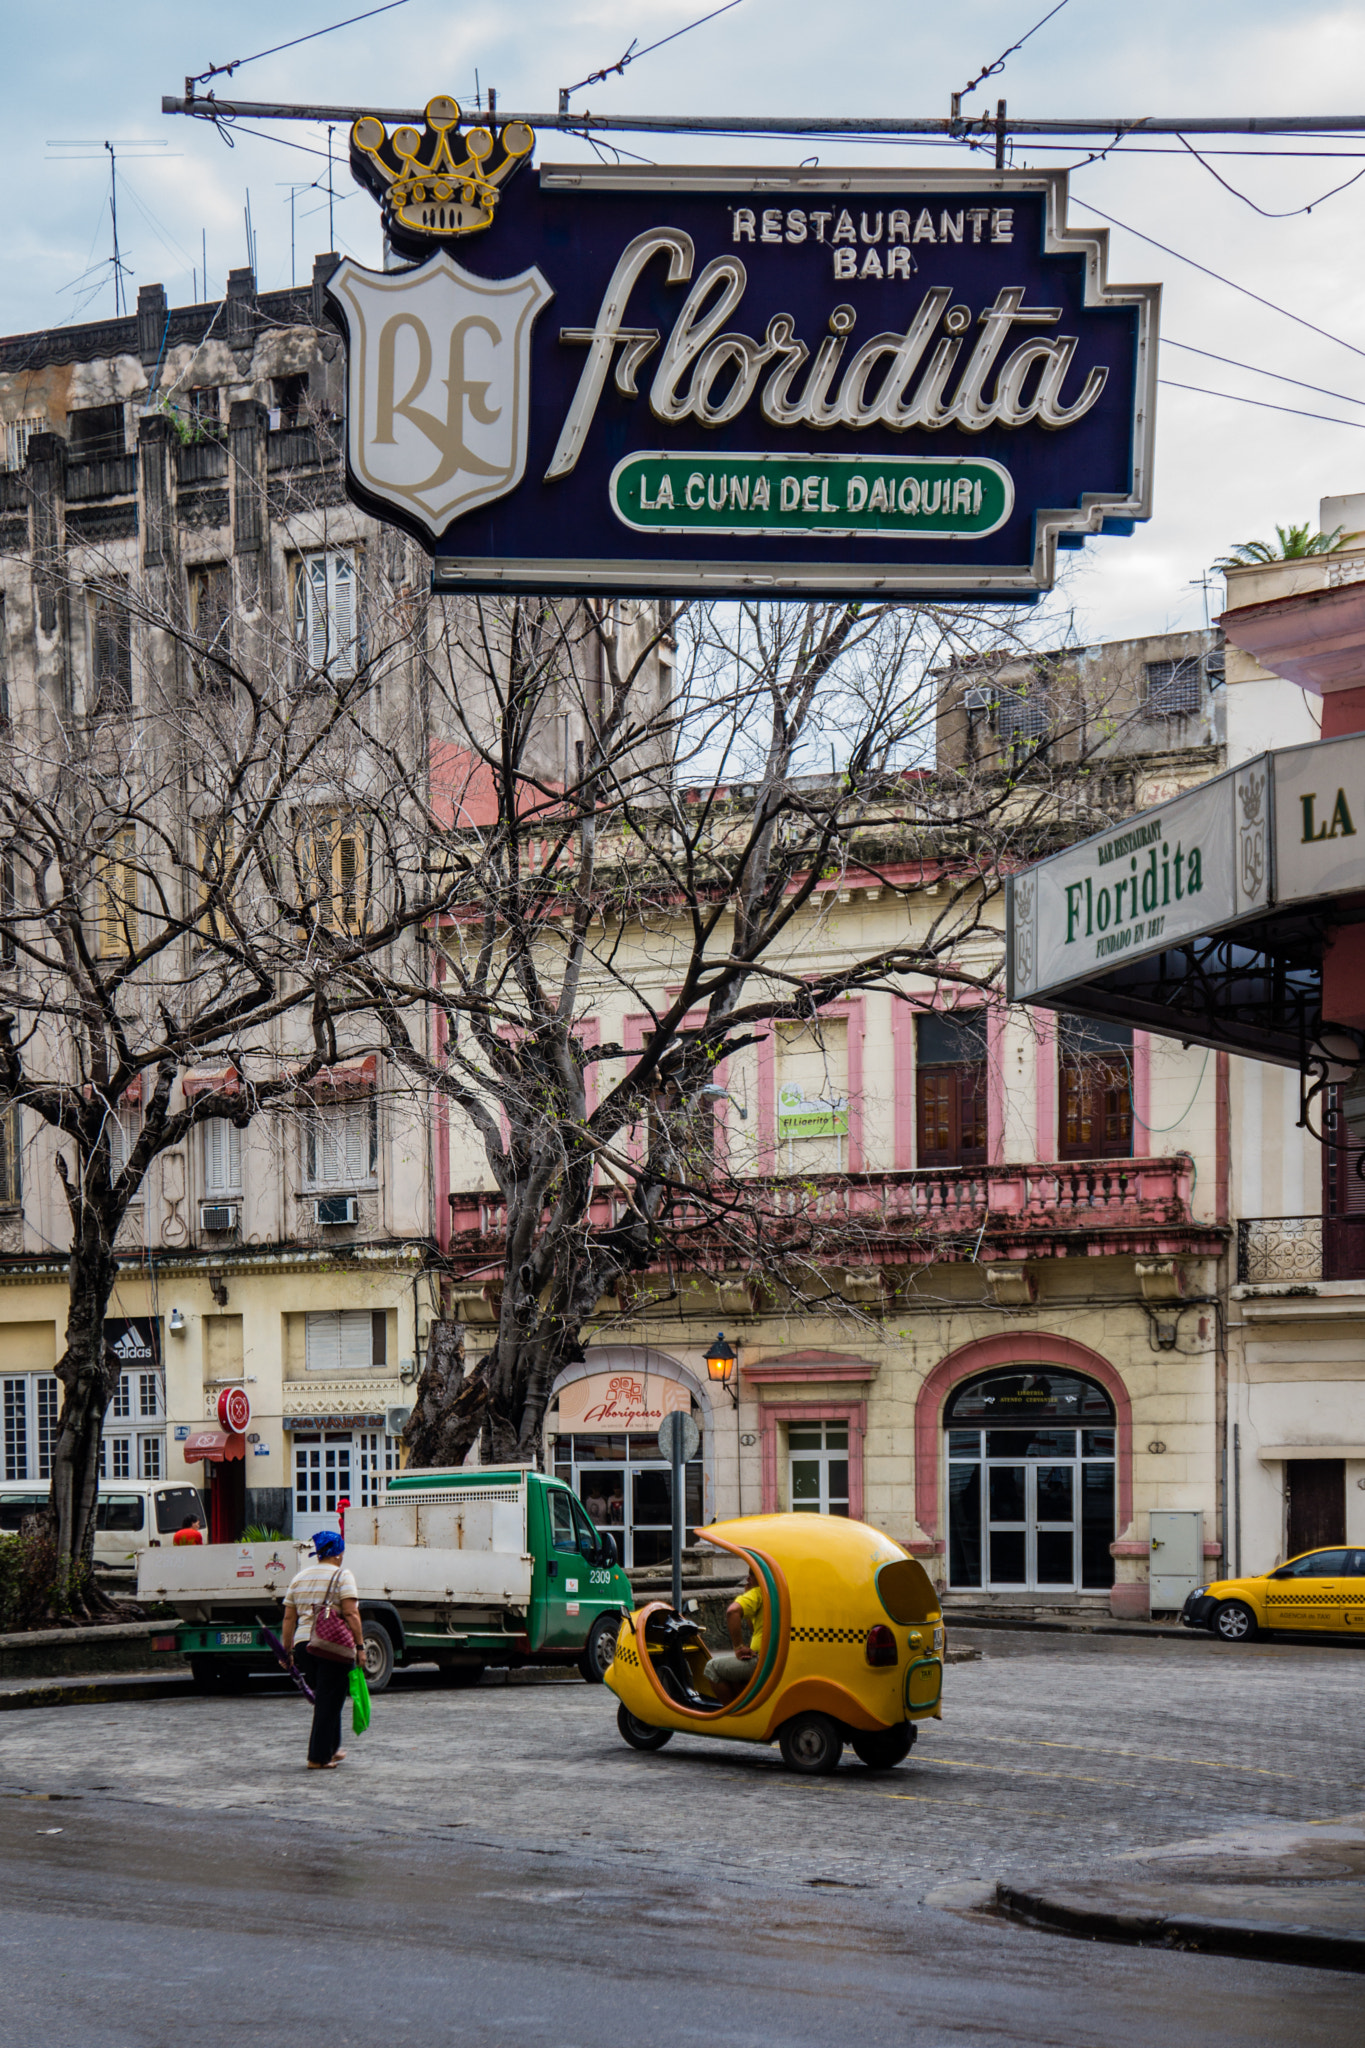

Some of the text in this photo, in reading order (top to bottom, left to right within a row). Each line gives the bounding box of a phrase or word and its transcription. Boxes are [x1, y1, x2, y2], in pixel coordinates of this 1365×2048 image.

[732, 208, 1015, 243] RESTAURANTE
[834, 246, 912, 279] BAR
[640, 472, 983, 516] LA CUNA DEL DAIQUIRI
[1300, 787, 1357, 844] LA
[1098, 819, 1162, 866] BAR RESTAURANT
[1065, 840, 1204, 945] Floridita
[1096, 915, 1166, 959] FUNDADO EN 1817
[783, 1118, 792, 1127] El
[589, 1570, 611, 1584] 2309
[1280, 1612, 1307, 1620] AGENCIA
